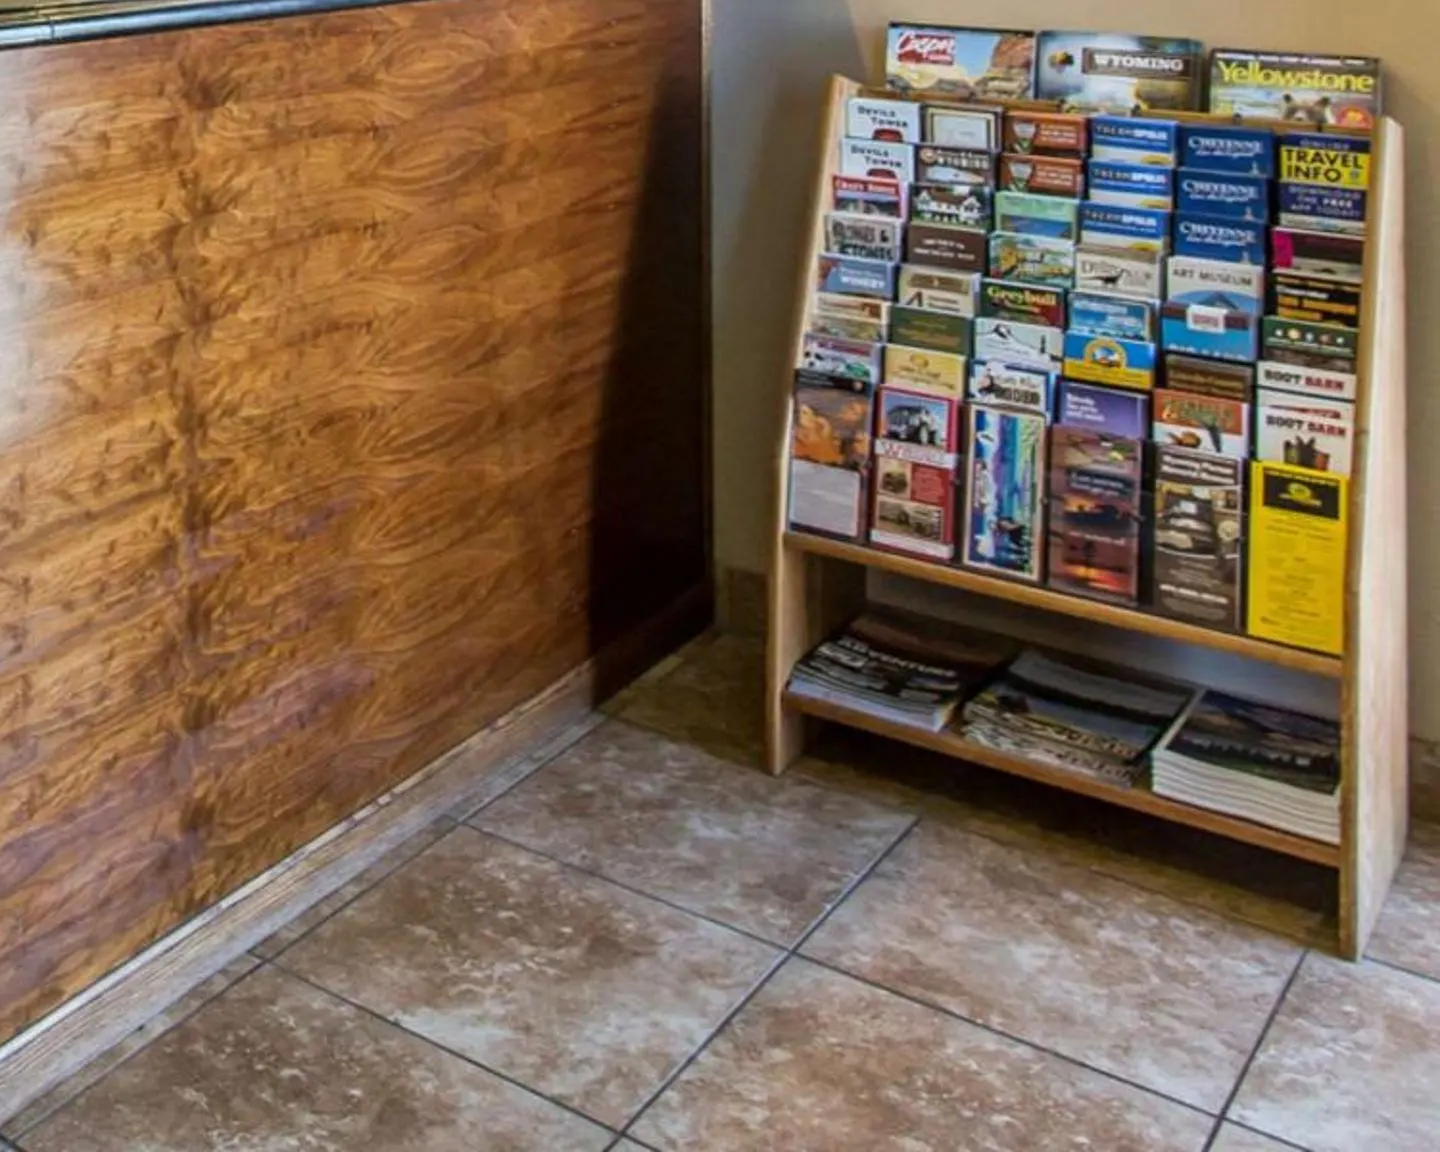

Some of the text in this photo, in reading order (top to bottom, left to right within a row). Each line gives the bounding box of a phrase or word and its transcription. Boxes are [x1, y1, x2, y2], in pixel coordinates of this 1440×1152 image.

[1092, 52, 1185, 73] WYOMING
[1217, 59, 1376, 92] Yellowstone
[1285, 148, 1365, 170] TRAVEL
[1286, 164, 1342, 183] INFO
[1172, 268, 1253, 286] ART MUSEUM
[1264, 369, 1302, 384] BOOT
[1265, 414, 1306, 428] BOOT
